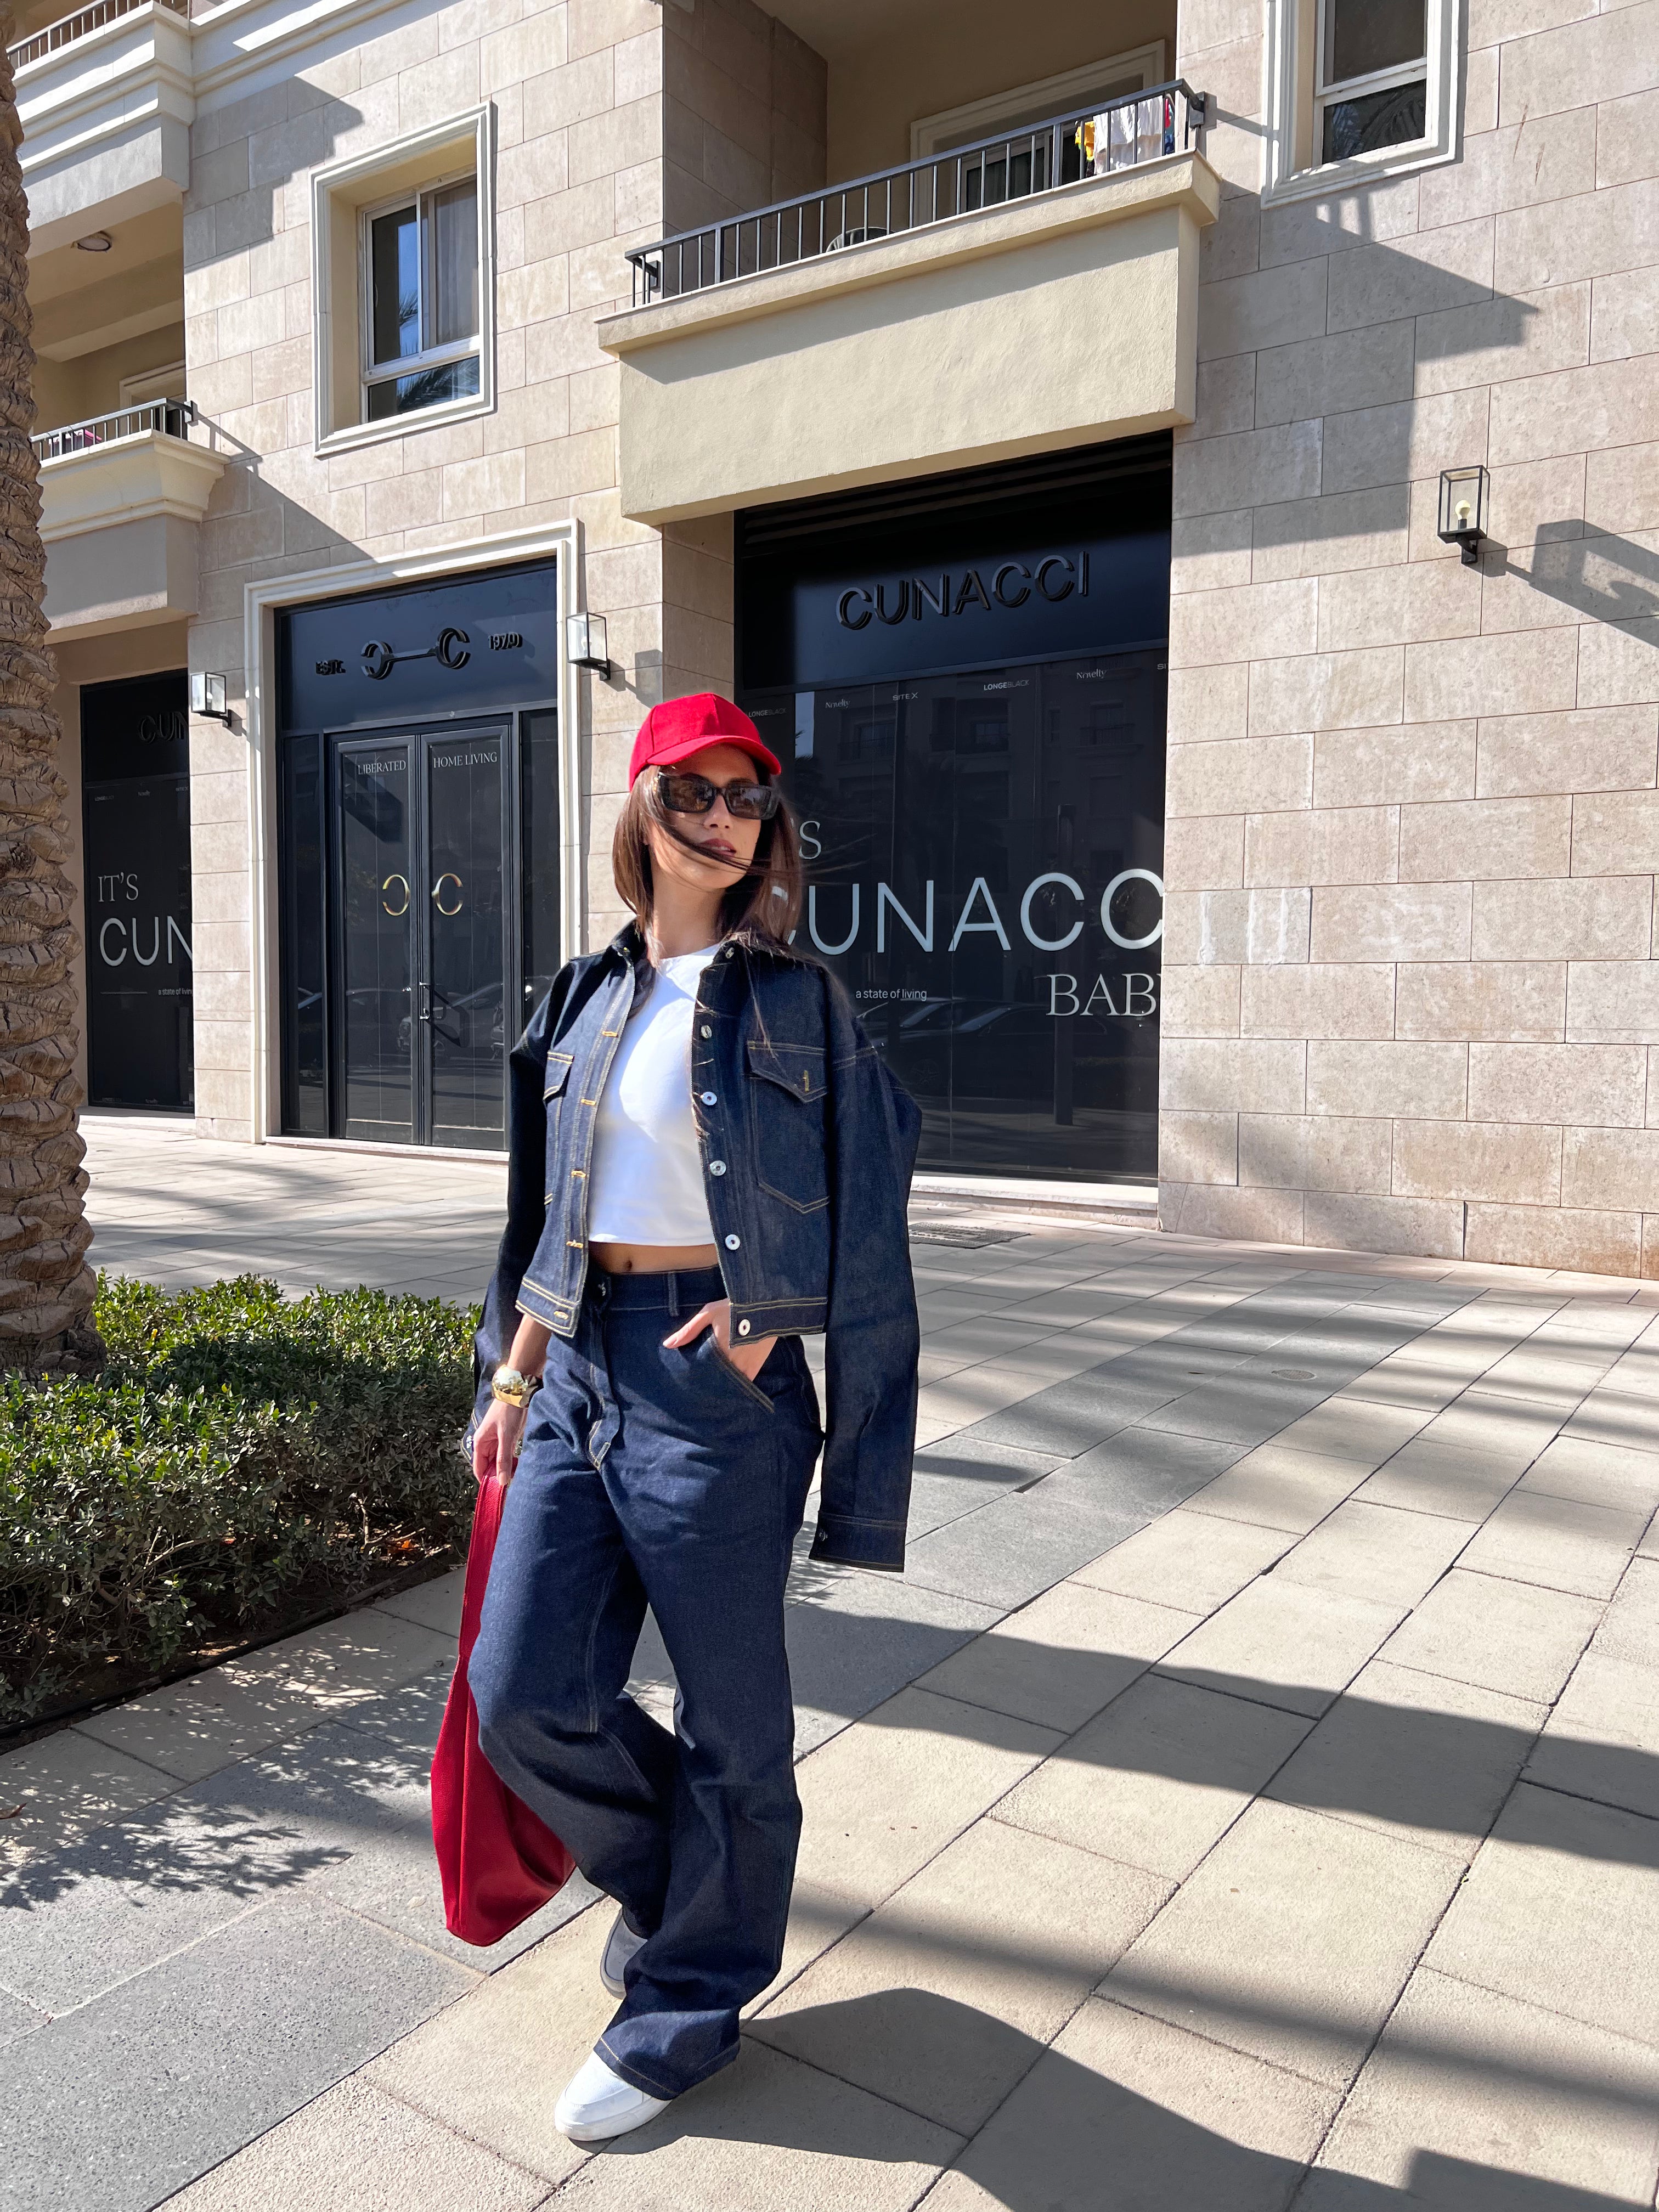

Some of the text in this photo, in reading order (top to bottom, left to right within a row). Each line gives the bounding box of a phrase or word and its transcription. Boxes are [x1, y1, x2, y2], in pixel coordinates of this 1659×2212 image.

[836, 551, 1089, 630] CUNACCI
[825, 699, 850, 708] Novelty
[358, 760, 407, 775] LIBERATED
[433, 752, 498, 768] HOME LIVING
[98, 872, 139, 902] IT'S
[99, 916, 193, 967] CUN
[863, 989, 888, 998] state
[890, 989, 900, 998] of
[902, 989, 927, 1002] living
[1046, 973, 1161, 1016] BAB
